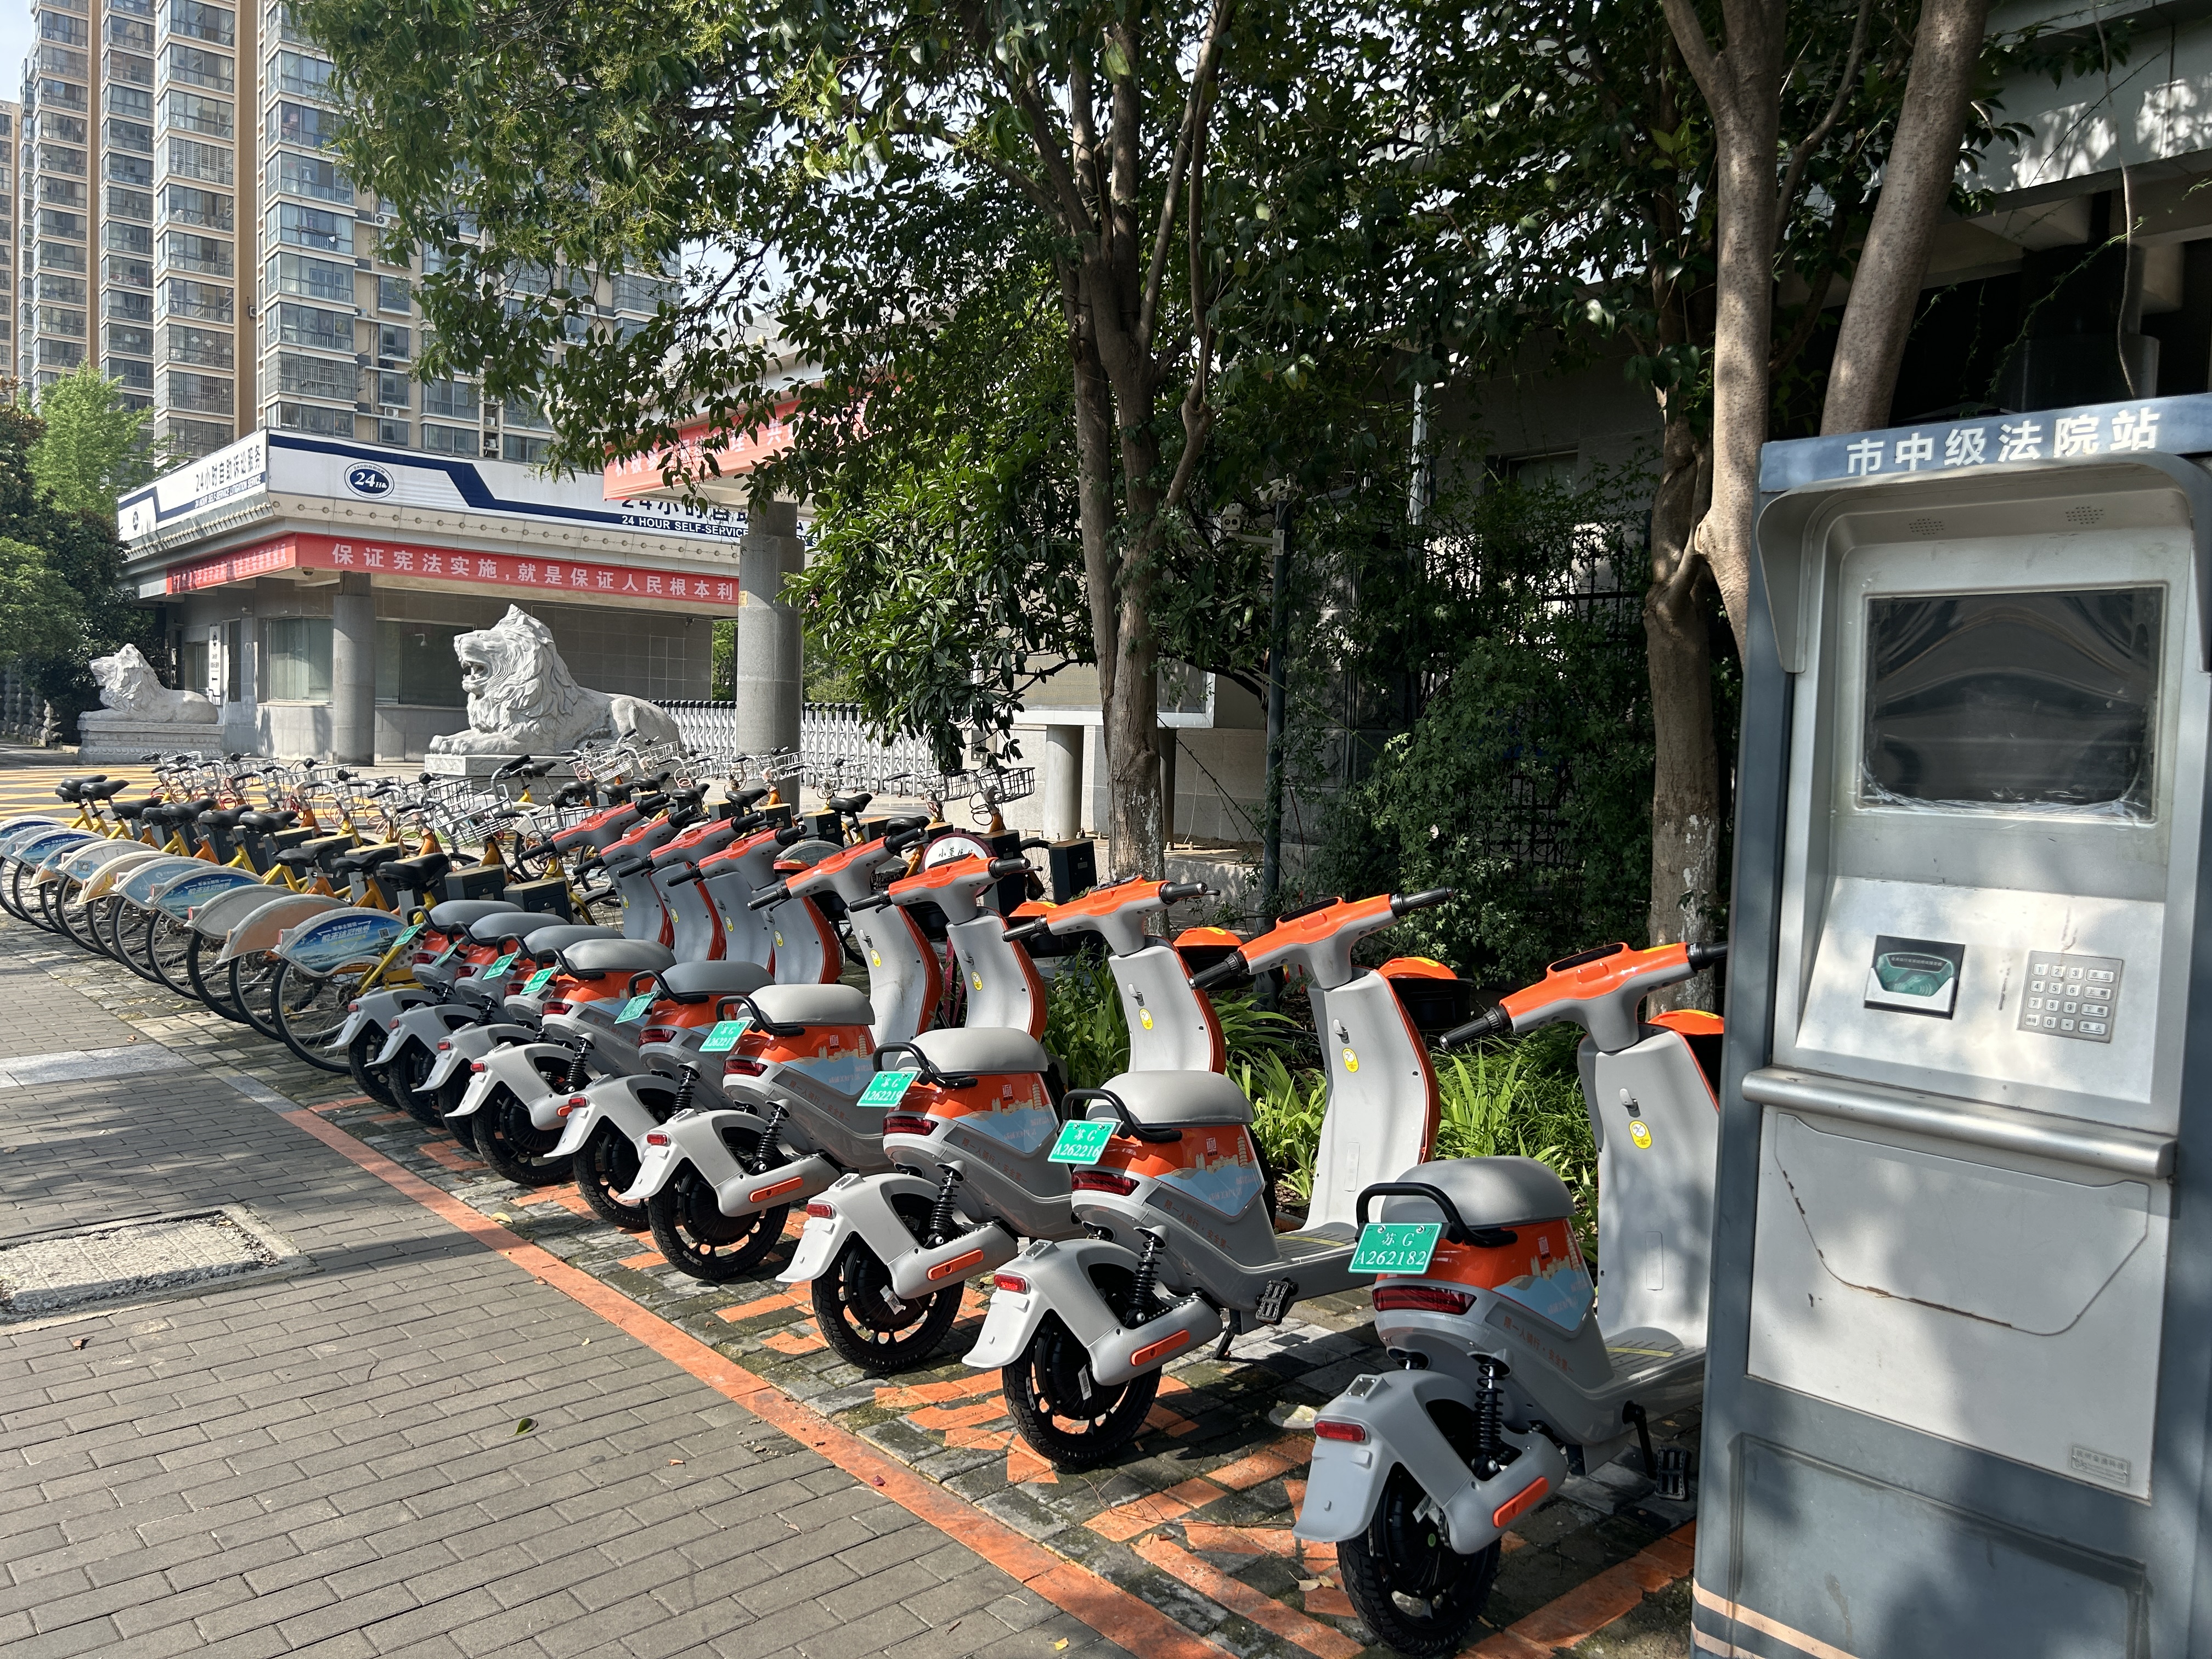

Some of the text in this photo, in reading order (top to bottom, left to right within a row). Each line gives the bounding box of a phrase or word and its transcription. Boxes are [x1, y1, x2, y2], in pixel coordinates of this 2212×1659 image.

[1847, 408, 2160, 476] 市中级法院站
[196, 444, 261, 492] 24小时自助诉讼服务
[247, 474, 261, 489] SERVICE
[622, 515, 749, 537] 24 HOUR SELF-SERVICE
[862, 1090, 904, 1101] A262219
[1053, 1143, 1103, 1158] A262216
[1355, 1250, 1427, 1266] A262182
